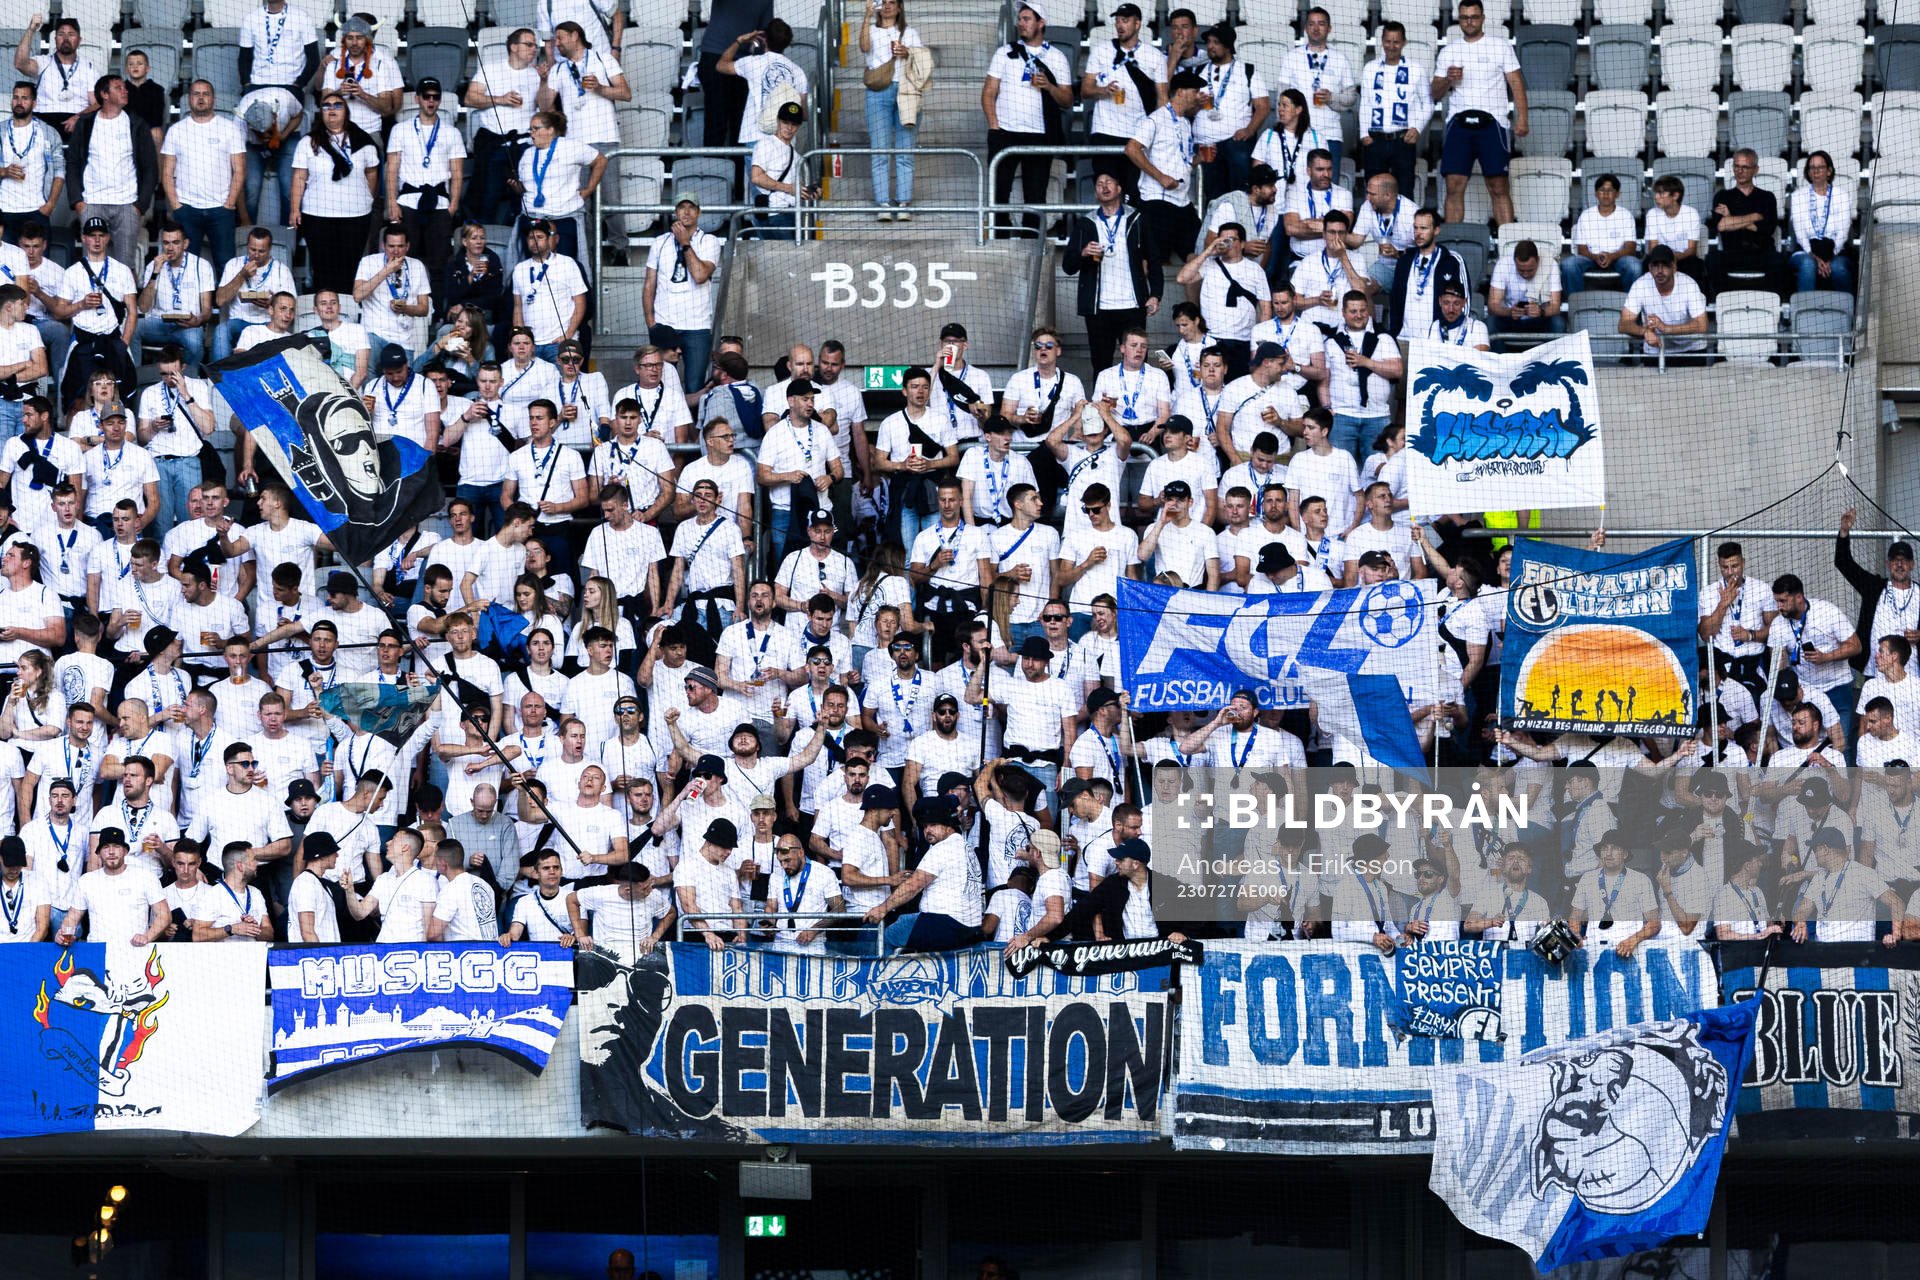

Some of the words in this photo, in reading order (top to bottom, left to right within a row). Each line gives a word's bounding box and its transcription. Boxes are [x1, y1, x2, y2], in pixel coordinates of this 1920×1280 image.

[825, 262, 952, 309] B335
[1522, 560, 1687, 597] FORMATION
[1559, 590, 1673, 617] LUZERN
[1134, 680, 1243, 707] FUSSBAL
[1526, 720, 1553, 730] NIZZA
[1554, 721, 1571, 731] BES
[1572, 723, 1605, 733] MILANO
[301, 951, 540, 998] MUSEGG
[1732, 988, 1903, 1088] BLUE
[664, 1002, 1166, 1124] GENERATION
